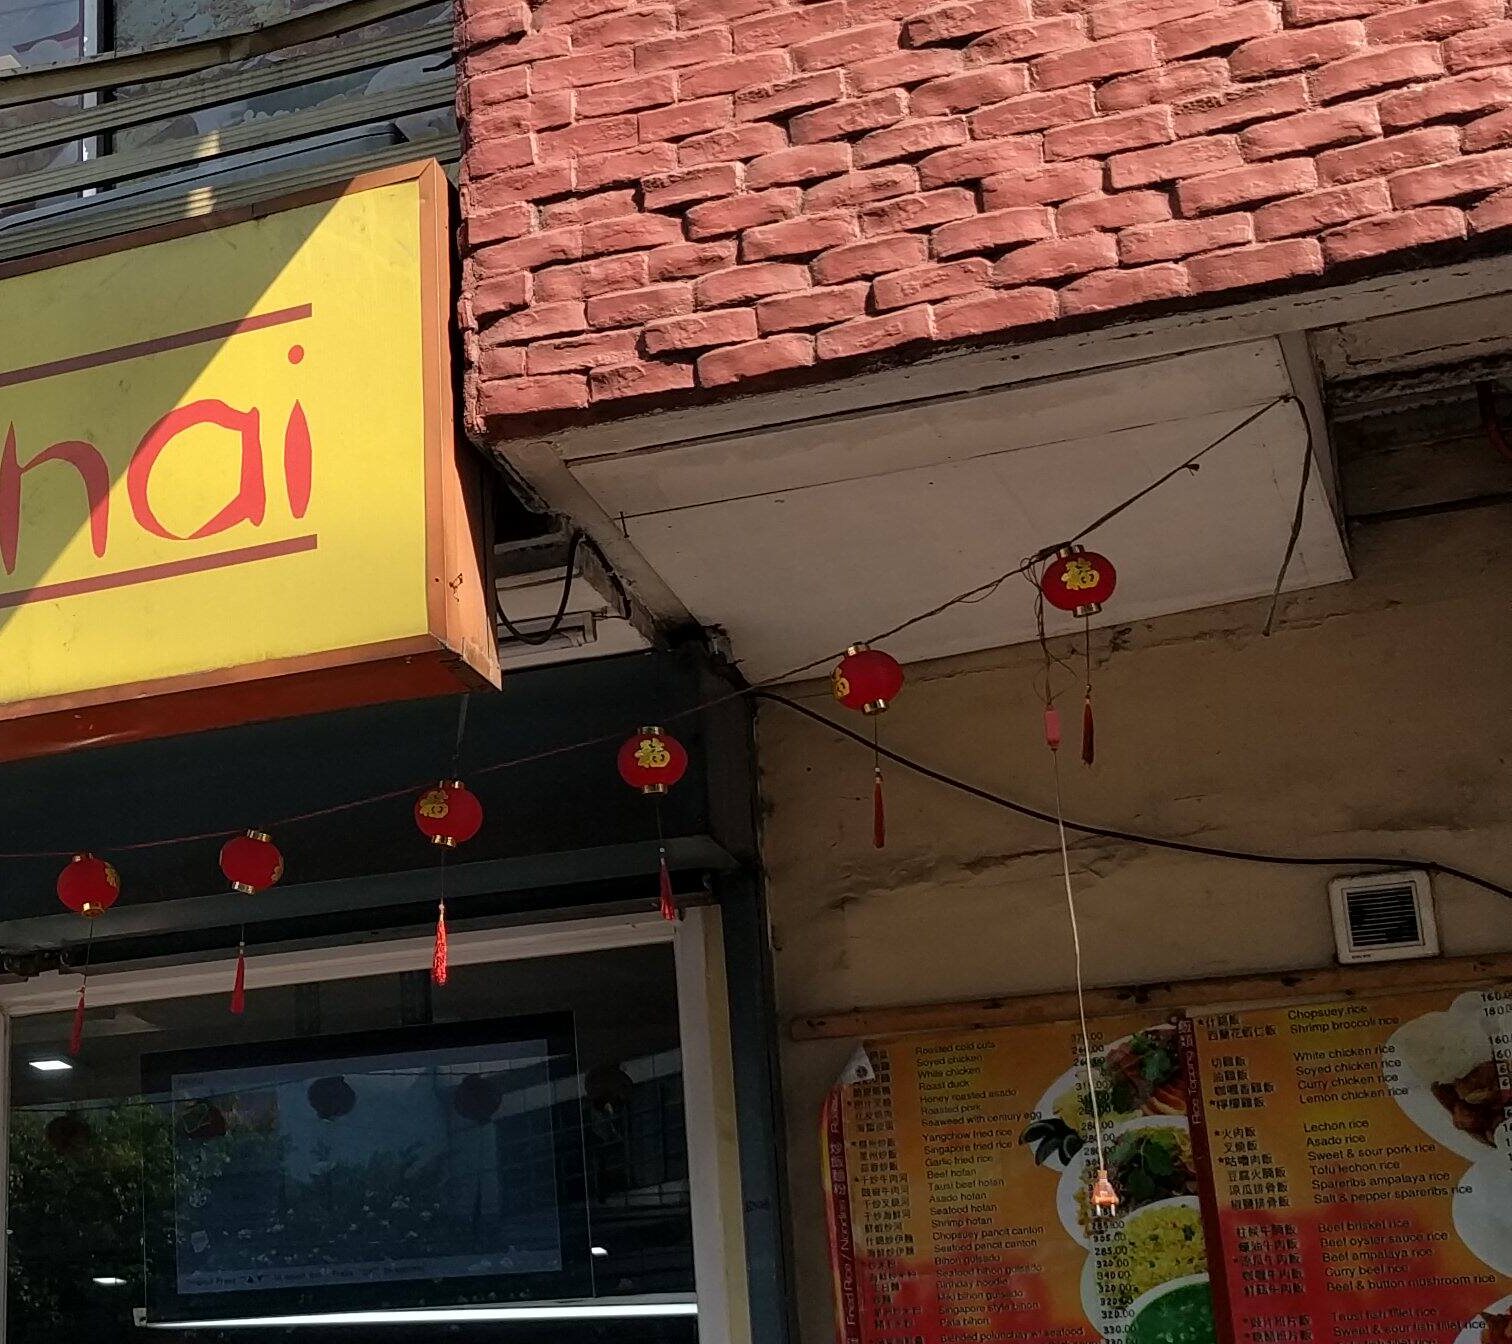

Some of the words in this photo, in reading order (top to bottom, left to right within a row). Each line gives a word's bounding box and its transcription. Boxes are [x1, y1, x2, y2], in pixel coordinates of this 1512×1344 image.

[1293, 1050, 1326, 1062] White
[1328, 1046, 1372, 1059] chicken
[1375, 1044, 1396, 1054] rice
[1297, 1079, 1328, 1091] Curry
[1331, 1075, 1374, 1087] chicken
[1377, 1073, 1399, 1083] rice
[1299, 1092, 1339, 1105] Lemon
[1341, 1088, 1385, 1101] chicken
[1388, 1086, 1409, 1097] rice
[1303, 1121, 1347, 1133] Lechon
[1348, 1119, 1370, 1129] rice
[1306, 1135, 1343, 1147] Asado
[1345, 1134, 1367, 1144] rice
[1308, 1150, 1344, 1162] Sweet
[1346, 1149, 1355, 1159] &
[1358, 1148, 1384, 1157] sour
[1386, 1145, 1412, 1157] pork
[1414, 1143, 1436, 1153] rice
[1310, 1164, 1335, 1175] Tofu
[1338, 1161, 1376, 1173] lechon
[1379, 1160, 1400, 1170] rice
[1312, 1177, 1367, 1191] Spareribs
[1369, 1173, 1426, 1186] ampalaya
[1429, 1171, 1450, 1181] rice
[1314, 1193, 1336, 1205] Salt
[1339, 1193, 1348, 1203] &
[1351, 1190, 1391, 1203] pepper
[1394, 1187, 1448, 1200] spareribs
[1450, 1184, 1473, 1194] rice
